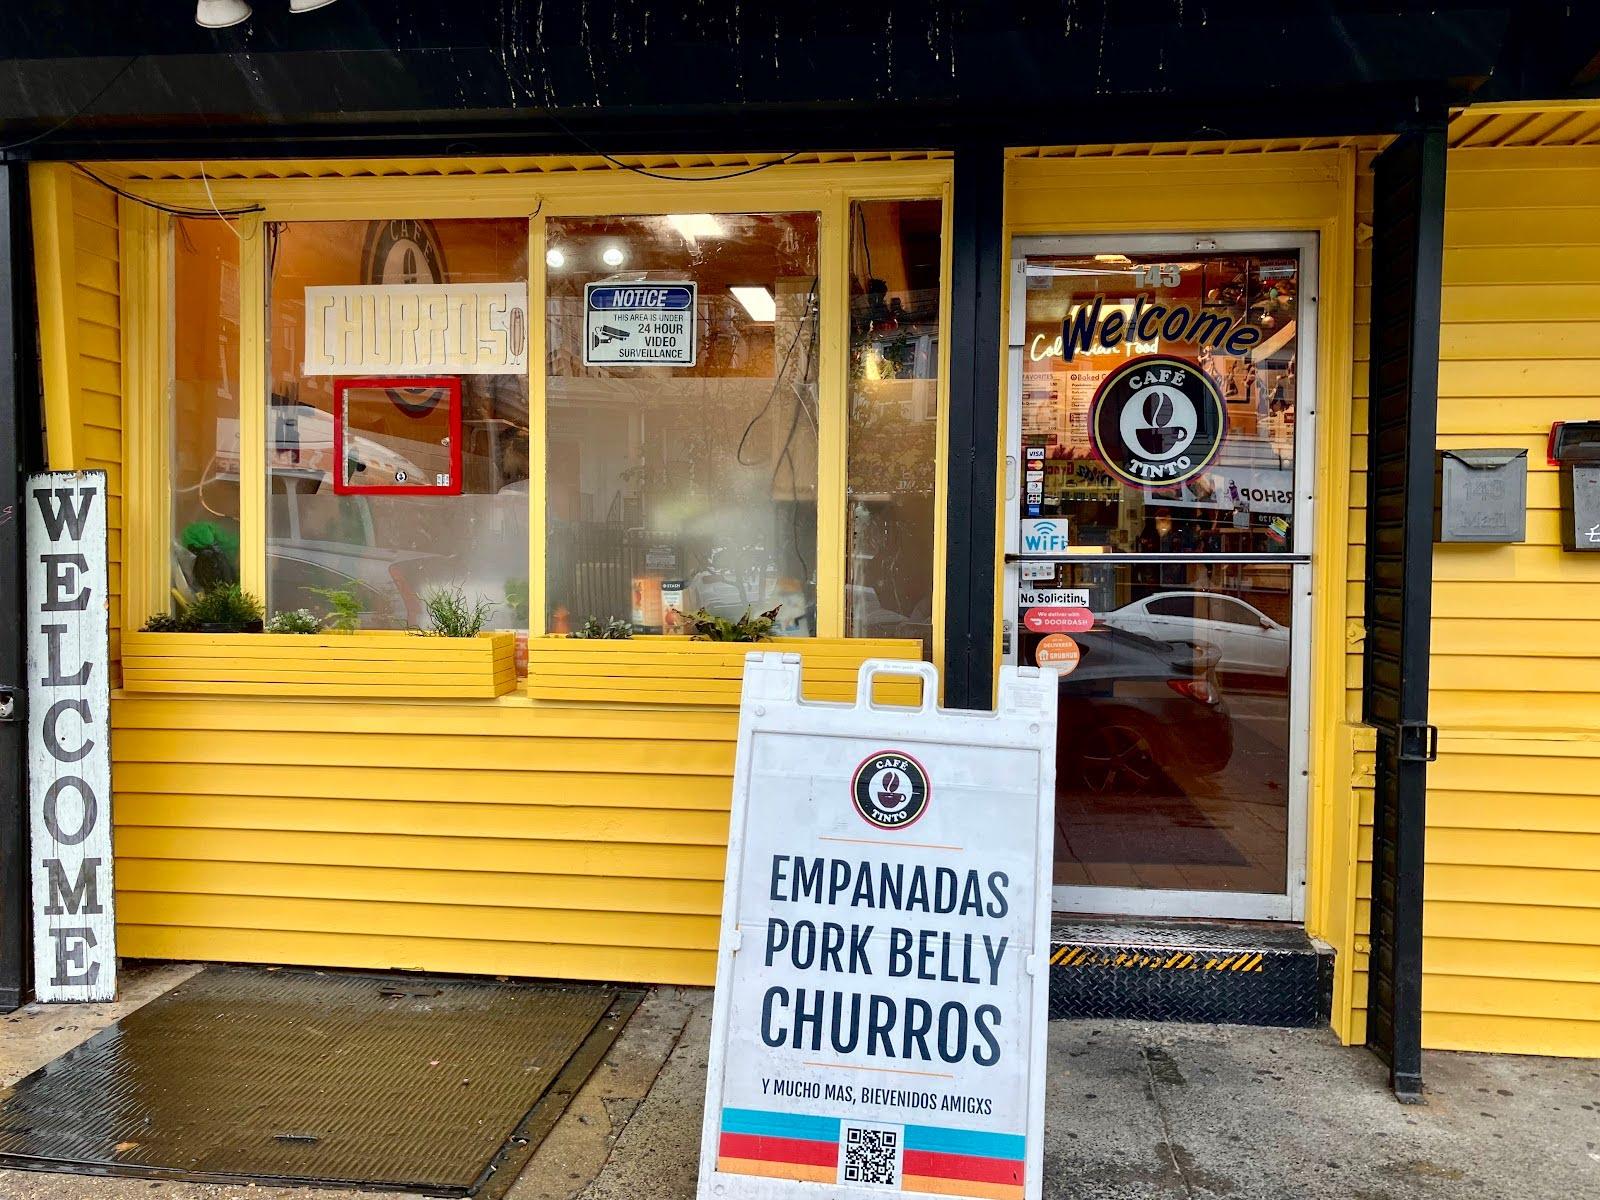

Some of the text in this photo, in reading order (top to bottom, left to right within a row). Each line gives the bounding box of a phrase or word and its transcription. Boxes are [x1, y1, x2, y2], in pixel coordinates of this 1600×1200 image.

[1135, 264, 1181, 288] 143
[612, 289, 668, 307] NOTICE
[659, 314, 683, 322] UNDER
[314, 293, 508, 366] CHURROS
[638, 324, 683, 335] 24 HOUR
[1062, 293, 1262, 363] Welcome
[645, 337, 677, 347] VIDEO
[619, 349, 683, 358] SURVEILLANCE
[1128, 369, 1187, 389] CAFÉ
[1129, 456, 1191, 479] TINTO
[1025, 535, 1066, 551] WiFi
[1020, 593, 1035, 604] No
[1050, 651, 1078, 660] GRUBHUB
[33, 487, 104, 987] WELCOME
[876, 758, 909, 771] CAFÉ
[871, 808, 908, 823] TINTO
[770, 854, 1009, 919] EMPANADAS
[765, 917, 1009, 986] PORK BELLY
[761, 985, 1001, 1067] CHURROS
[762, 1078, 992, 1115] Y MUCHO MAS, BIEVENIDOS AMIGXS
